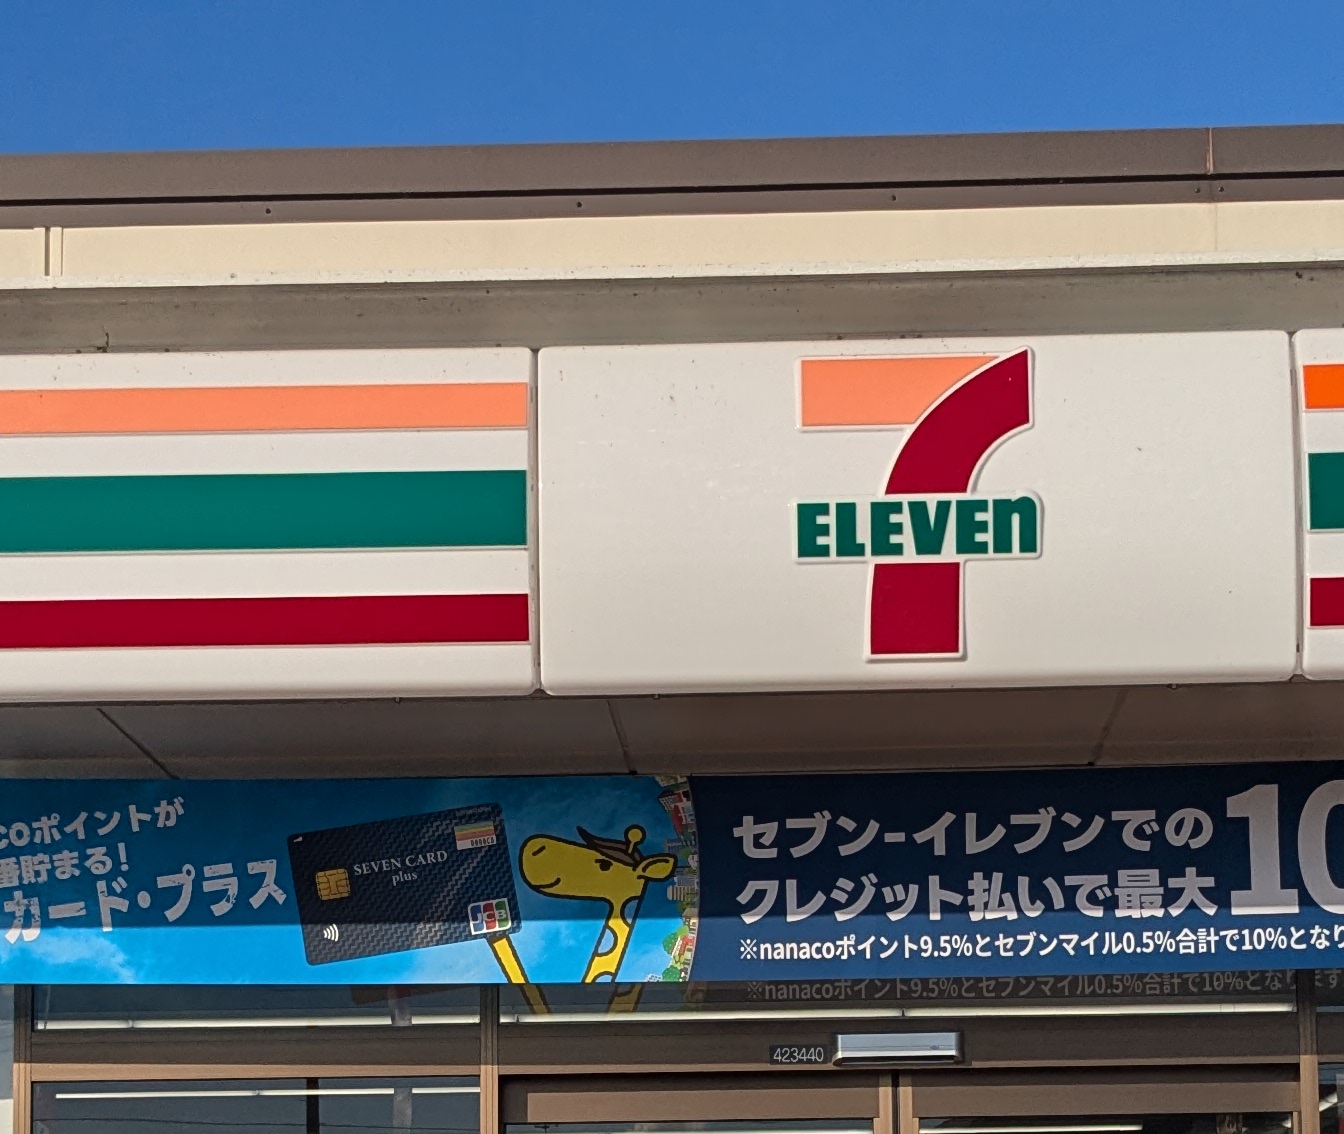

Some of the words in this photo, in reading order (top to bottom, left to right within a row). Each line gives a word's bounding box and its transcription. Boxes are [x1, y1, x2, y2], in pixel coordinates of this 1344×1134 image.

[799, 347, 1031, 655] 7
[354, 857, 402, 876] SEVEN
[406, 850, 448, 868] CARD
[392, 871, 418, 886] plus
[734, 868, 1219, 925] クレジット払いで最大
[470, 908, 508, 925] JCB
[772, 1045, 824, 1063] 423440
